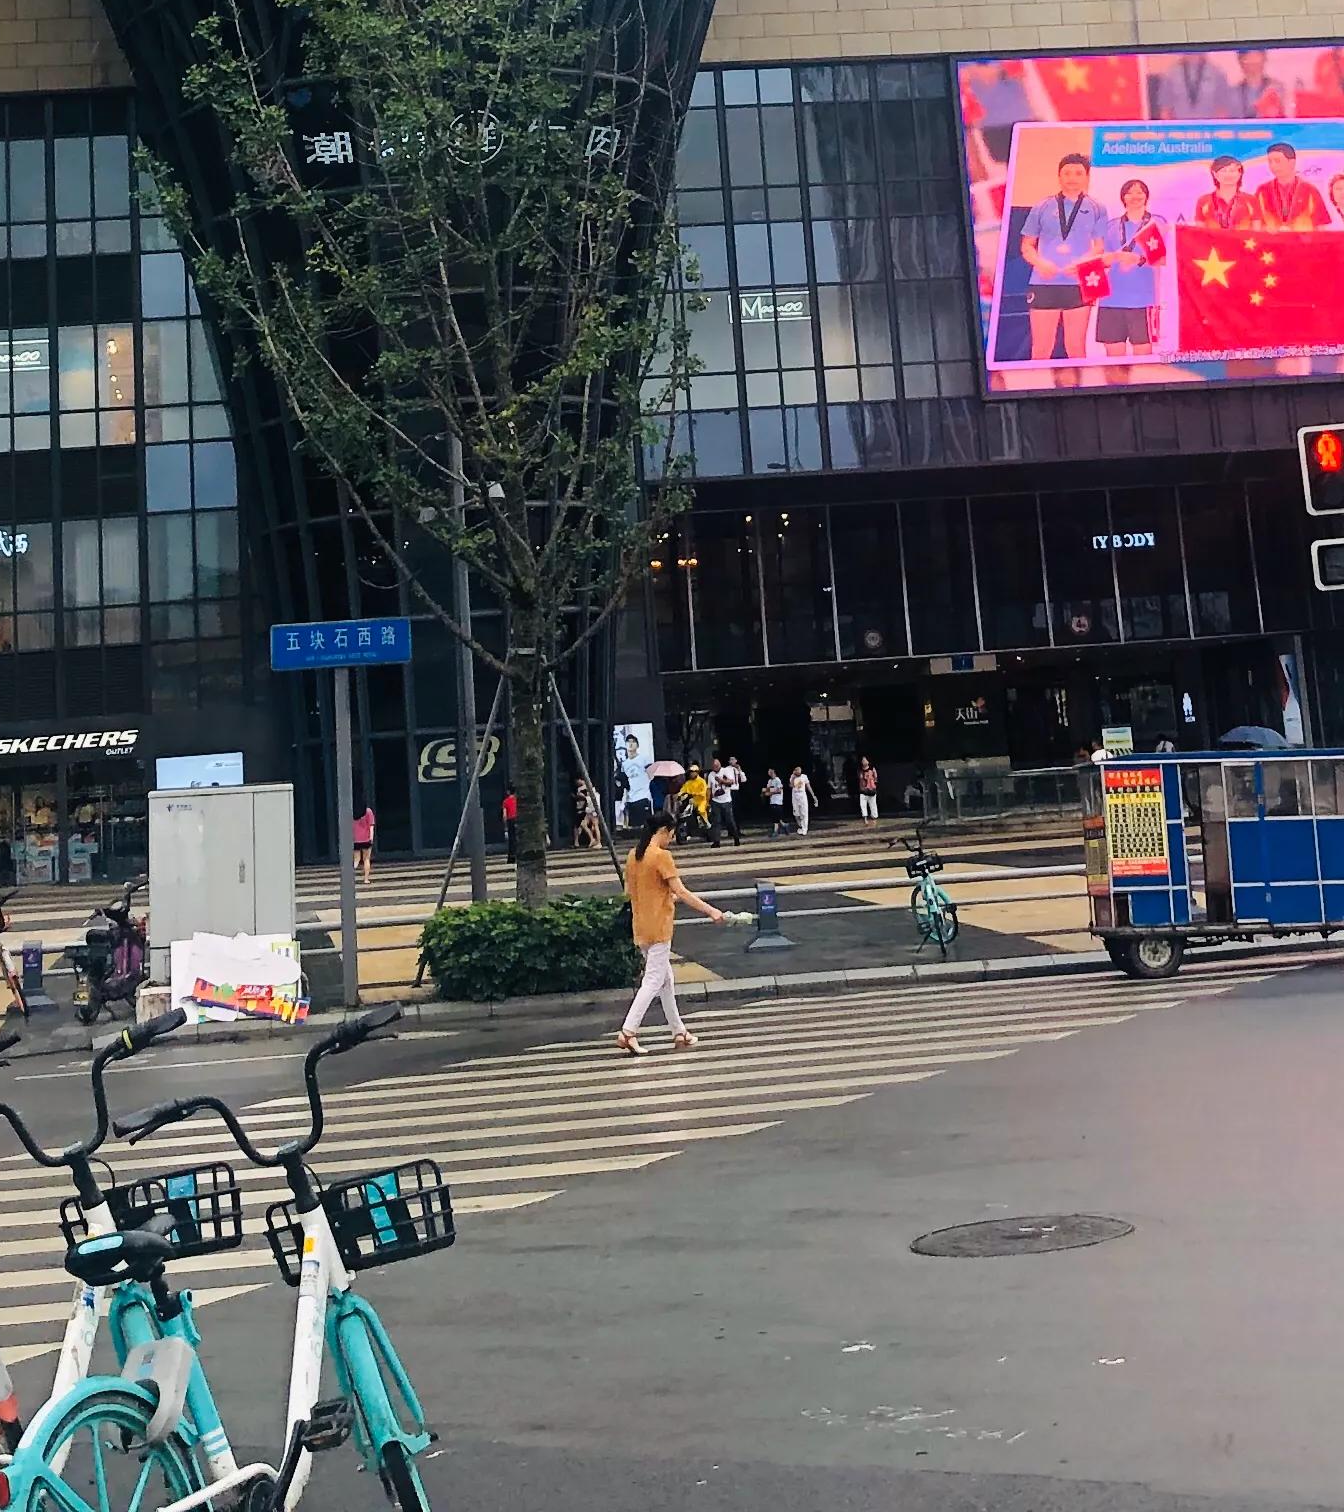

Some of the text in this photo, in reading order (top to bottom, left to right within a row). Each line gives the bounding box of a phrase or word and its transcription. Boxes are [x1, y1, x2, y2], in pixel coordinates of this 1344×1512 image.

[1102, 141, 1213, 155] Adelaide Australia
[286, 625, 396, 651] 五块石西路
